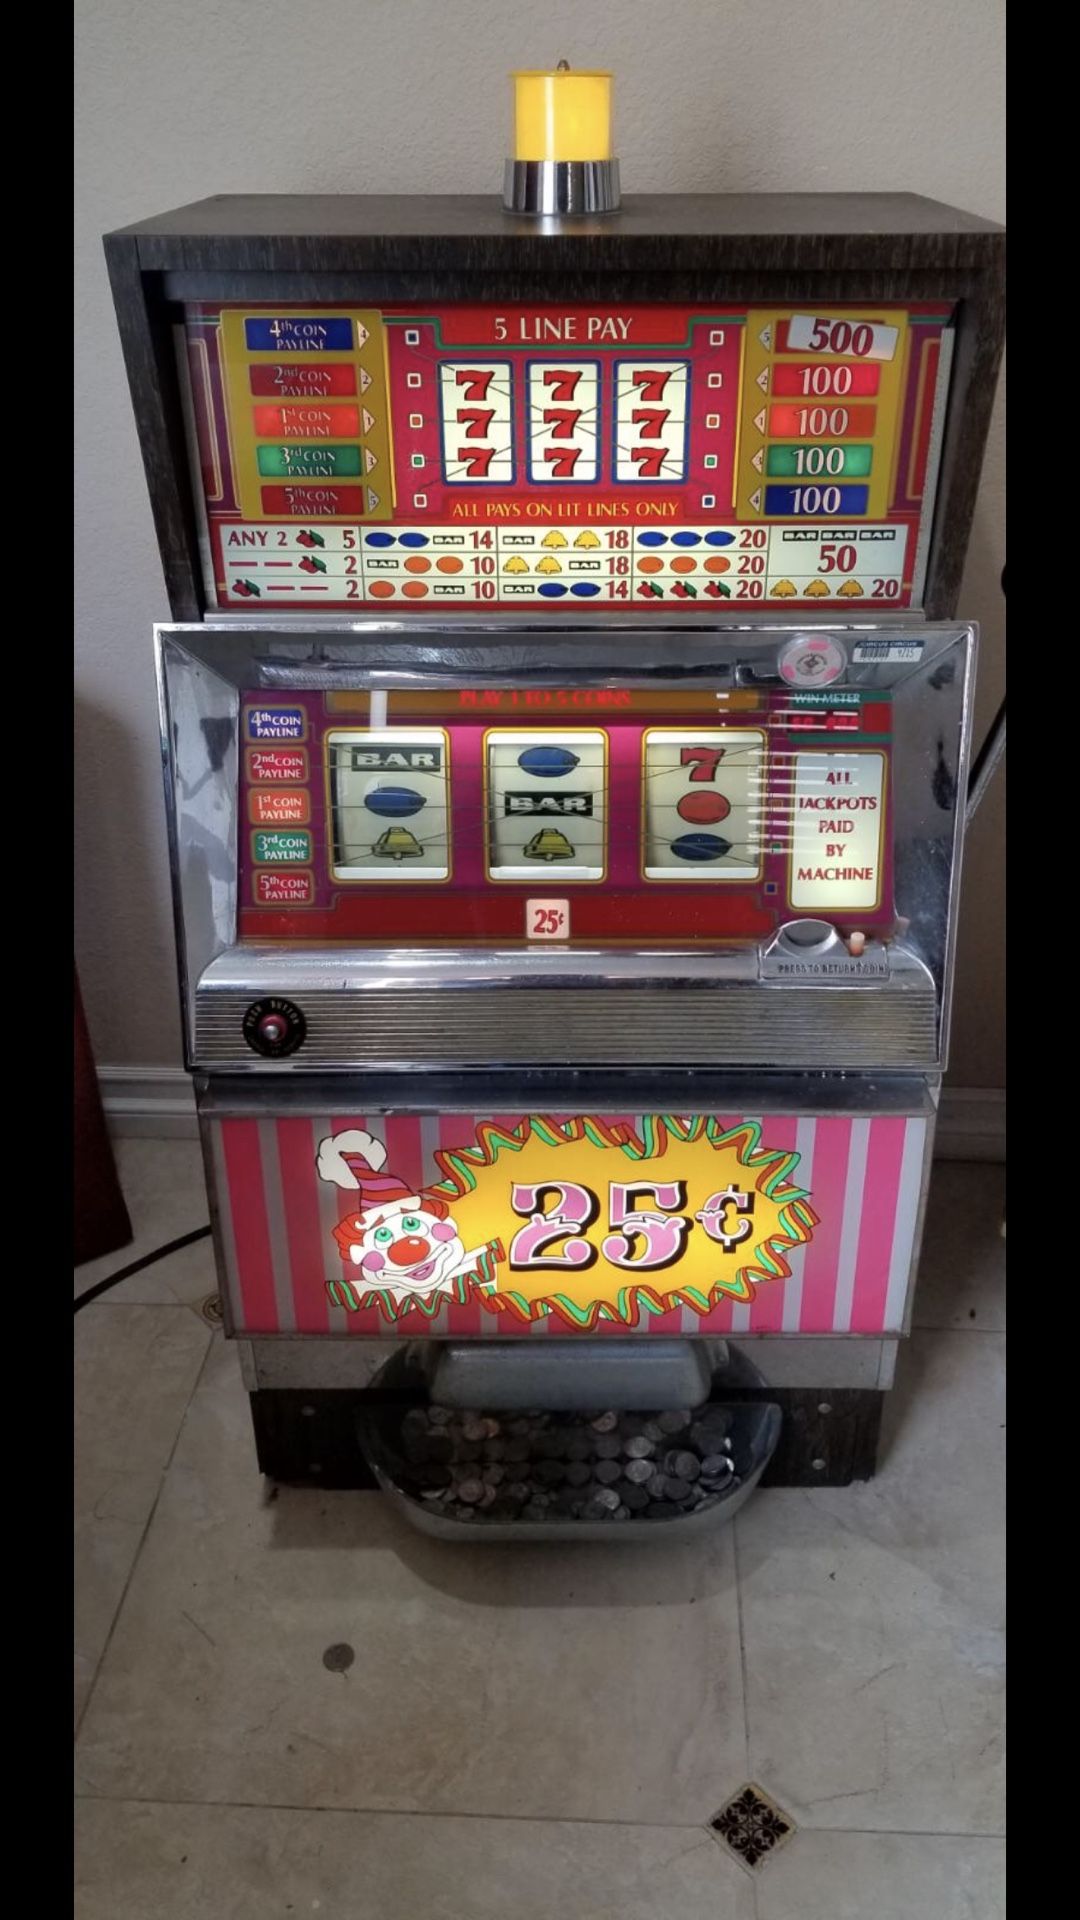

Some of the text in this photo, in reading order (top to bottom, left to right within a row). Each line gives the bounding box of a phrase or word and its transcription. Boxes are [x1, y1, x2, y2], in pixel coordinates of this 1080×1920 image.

[269, 319, 328, 338] 4th COIN
[360, 329, 366, 339] 4
[494, 317, 633, 340] 5 LINE PAY
[808, 318, 874, 356] 500
[272, 365, 331, 384] 2nd COIN
[362, 375, 369, 385] 2
[797, 366, 852, 395] 100
[455, 370, 496, 401] 7
[543, 370, 583, 401] 7
[632, 370, 673, 401] 7
[298, 410, 331, 422] COIN
[456, 408, 497, 439] 7
[543, 408, 583, 439] 7
[632, 408, 672, 439] 7
[794, 407, 849, 436] 100
[281, 447, 335, 465] 3rd COIN
[457, 447, 497, 477] 7
[543, 447, 583, 477] 7
[631, 447, 670, 477] 7
[792, 447, 845, 475] 100
[284, 487, 339, 504] 5th COIN
[789, 487, 842, 514] 100
[452, 502, 679, 518] ALL PAYS ON LIT LINES ONLY
[227, 529, 356, 549] ANY 2 5
[433, 530, 493, 549] BAR 14
[503, 529, 629, 549] BAR 18
[739, 529, 767, 548] 20
[783, 530, 894, 540] BAR BAR BAR
[344, 555, 357, 574] 2
[367, 556, 495, 575] BAR 10
[569, 555, 629, 575] BAR 18
[738, 555, 765, 574] 20
[817, 544, 857, 573] 50
[346, 579, 359, 598] 2
[434, 580, 495, 599] BAR 10
[503, 580, 628, 599] BAR 14
[736, 579, 763, 598] 20
[871, 578, 899, 598] 20
[251, 711, 302, 727] 4th COIN
[257, 728, 299, 737] PAYLINE
[252, 753, 303, 769] 2nd COIN
[356, 753, 434, 766] BAR
[680, 747, 726, 782] 7
[259, 769, 302, 779] PAYLINE
[825, 772, 853, 786] ALL
[256, 795, 302, 810] 1st COIN
[510, 797, 587, 811] BAR
[260, 810, 301, 819] PAYLINE
[818, 820, 854, 833] PAID
[258, 835, 308, 851] 3rd COIN
[826, 844, 846, 857] BY
[264, 851, 307, 860] PAYLINE
[260, 875, 309, 890] 5th COIN
[797, 868, 873, 881] MACHINE
[265, 890, 308, 899] PAYLINE
[510, 1180, 755, 1273] 25¢
